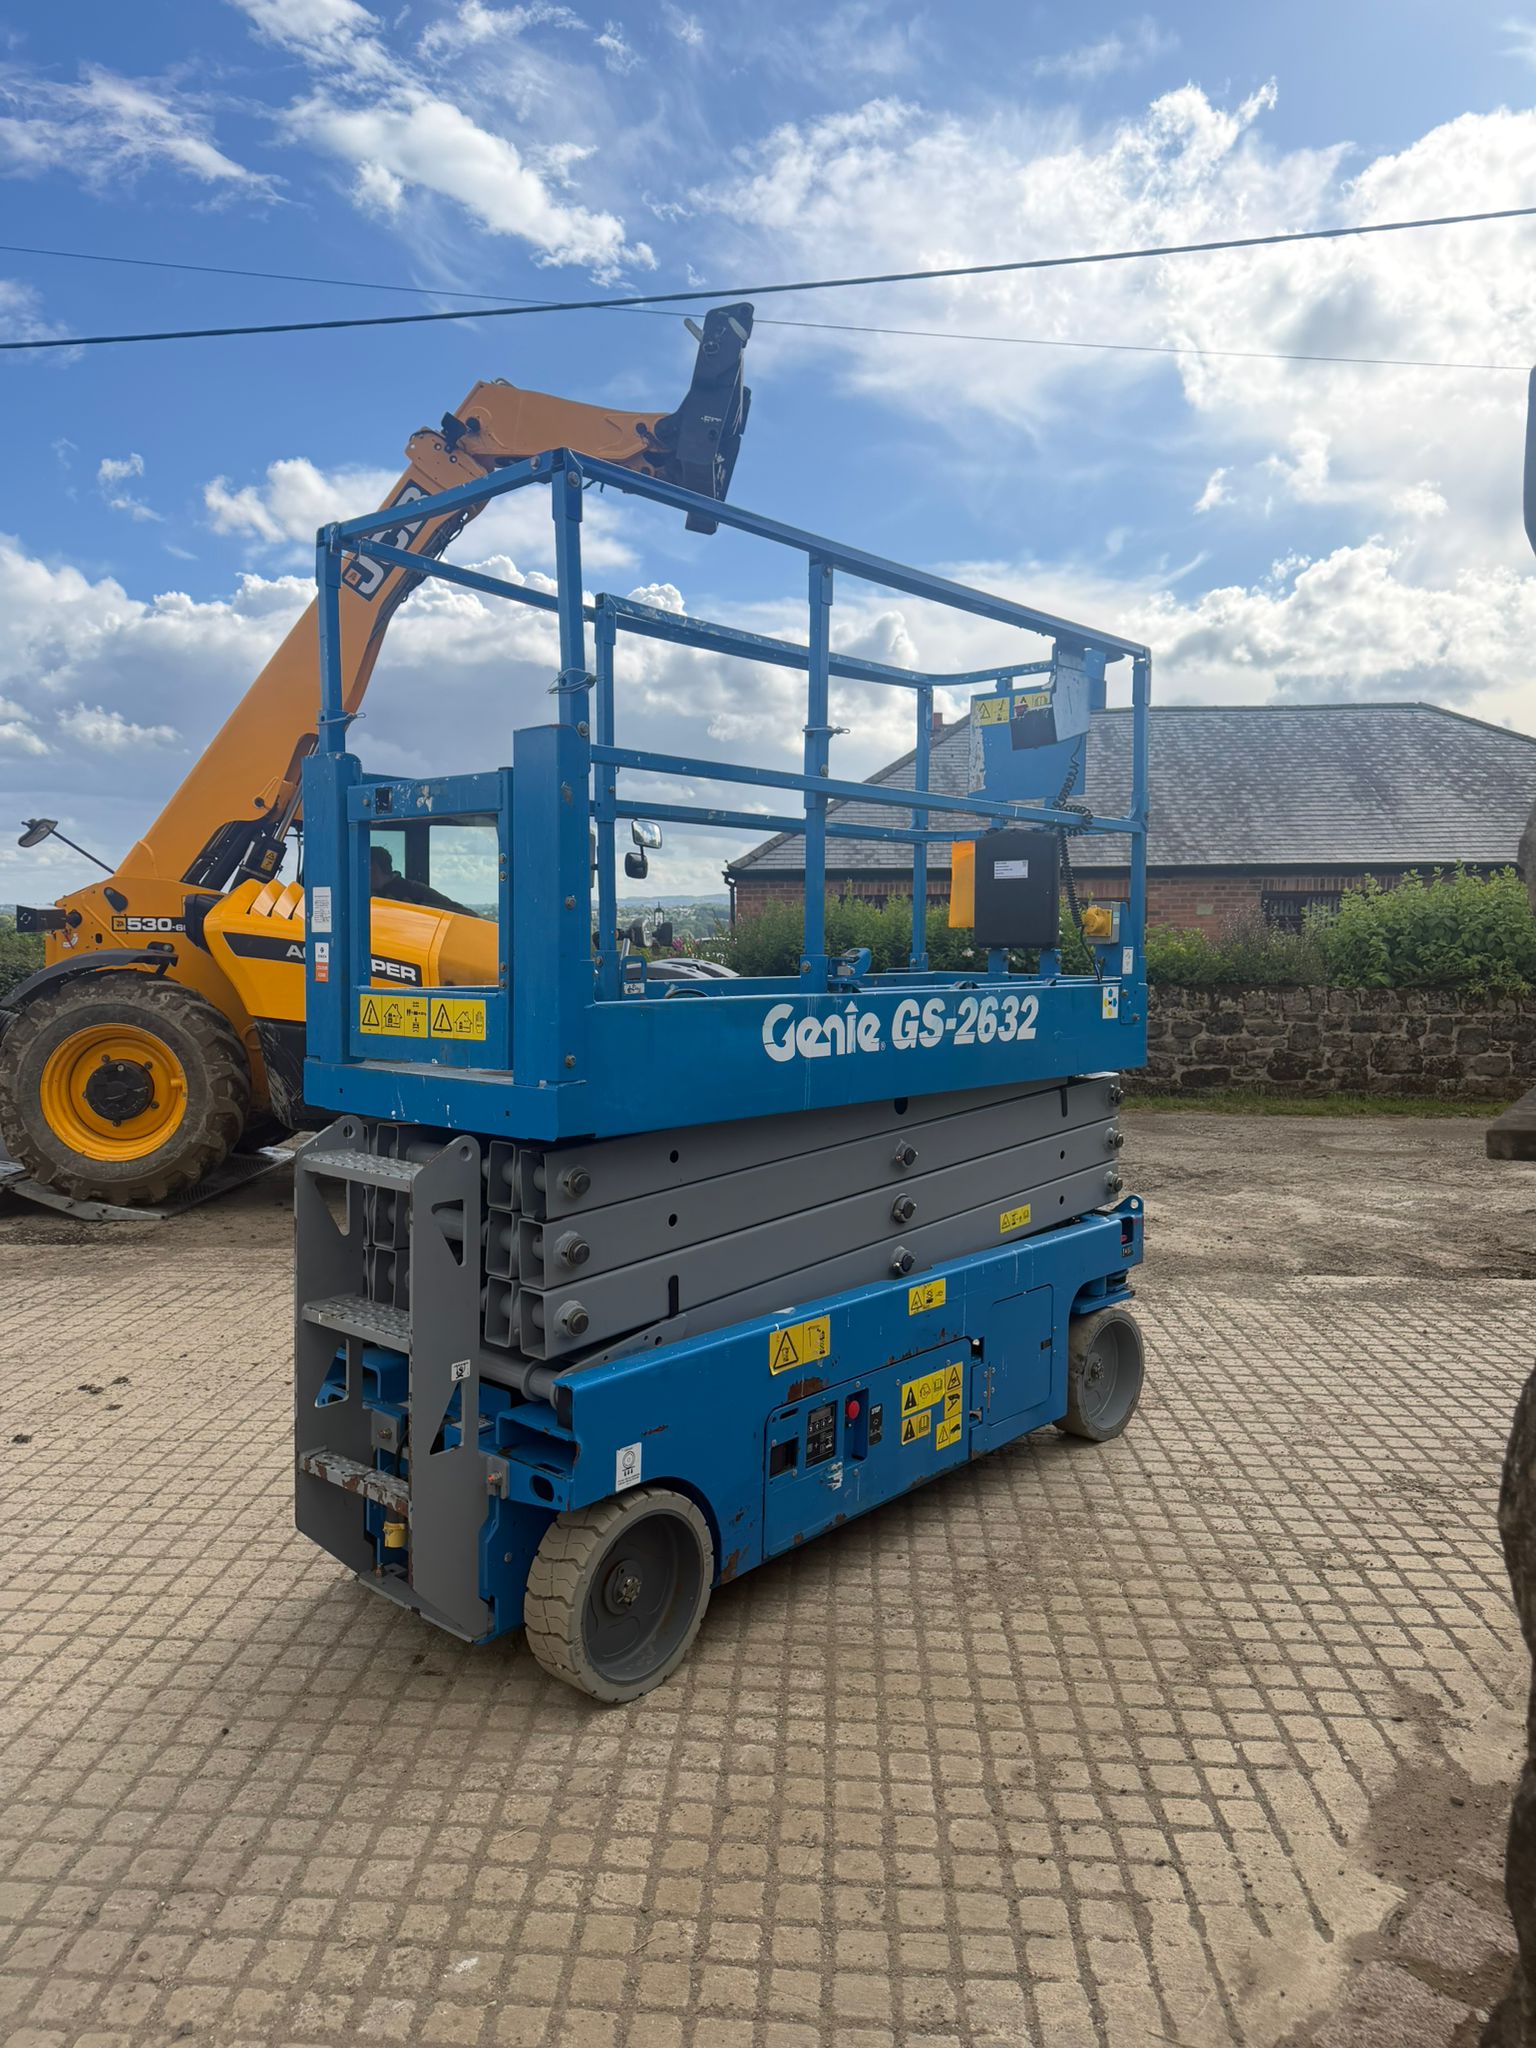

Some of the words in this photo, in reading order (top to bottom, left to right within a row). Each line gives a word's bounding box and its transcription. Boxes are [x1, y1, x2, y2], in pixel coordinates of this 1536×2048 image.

[127, 917, 186, 931] 530-6
[762, 1001, 881, 1062] Genie
[892, 995, 1039, 1050] GS-2632
